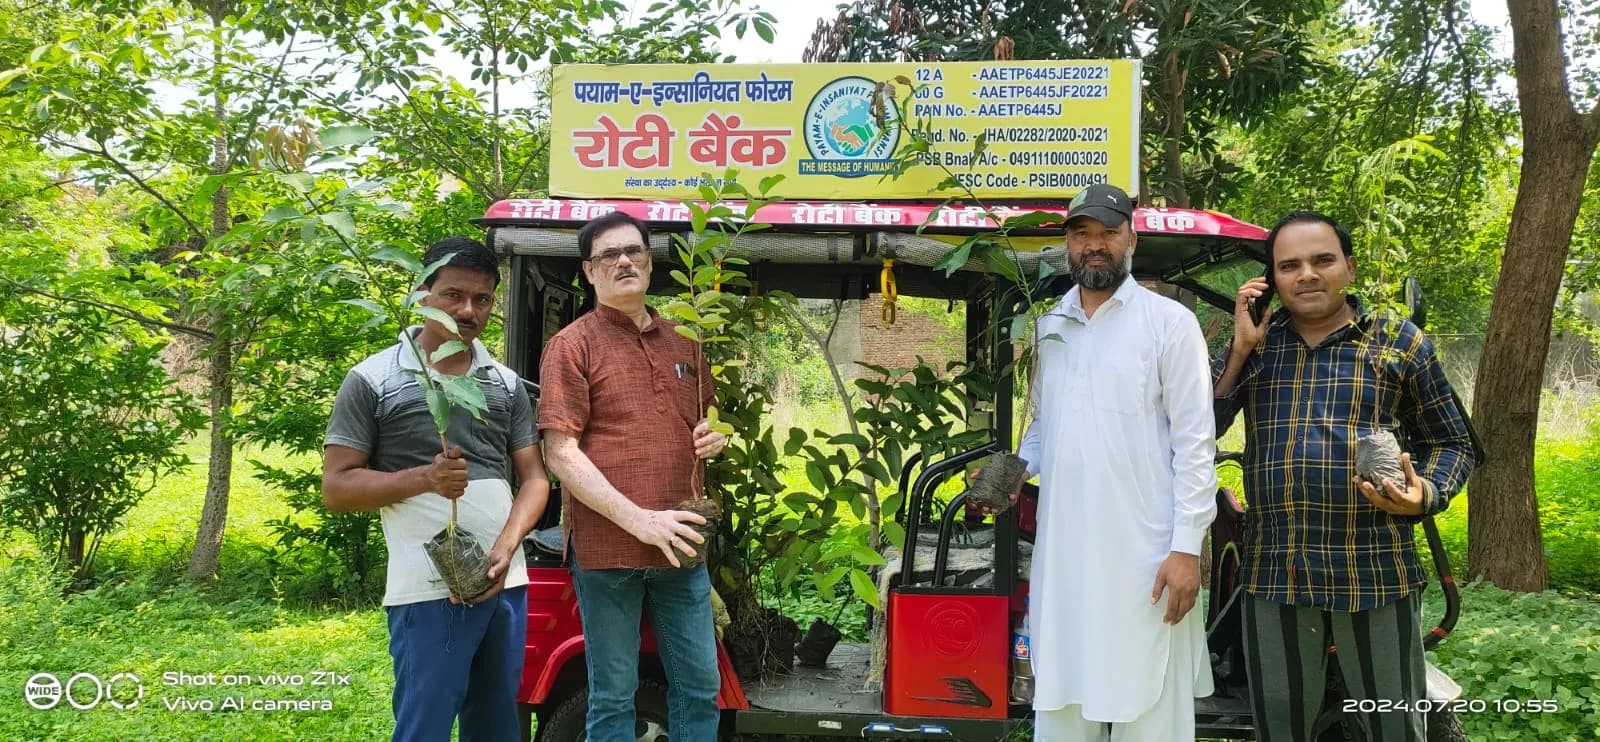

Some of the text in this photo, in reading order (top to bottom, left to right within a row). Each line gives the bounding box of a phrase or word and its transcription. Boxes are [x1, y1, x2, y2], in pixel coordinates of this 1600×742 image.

[916, 69, 930, 81] 12
[933, 69, 943, 81] A
[979, 67, 1109, 81] AAETP6445JE20221
[574, 72, 793, 106] पयाम-ए-इन्सानियत फोरम
[933, 86, 944, 99] G
[979, 85, 1108, 99] AAETP6445JF20221
[915, 104, 942, 117] PAN
[945, 104, 967, 117] No.
[978, 103, 1062, 117] AAETP6445J
[812, 86, 867, 156] PAYAM-E-INSANIYAT
[573, 113, 792, 169] रोटी बैंक
[949, 128, 969, 142] No.
[916, 151, 941, 166] PSB
[978, 151, 998, 166] A/c
[1009, 151, 1108, 166] 04911100003020
[802, 162, 900, 173] THE MESSAGE OF HUMAN
[643, 178, 653, 187] का
[986, 173, 1018, 188] Code
[1029, 173, 1108, 188] PSIB0000491
[509, 200, 563, 219] रोटी
[791, 203, 903, 225] रोटी बैंक
[1140, 208, 1195, 231] बैंक
